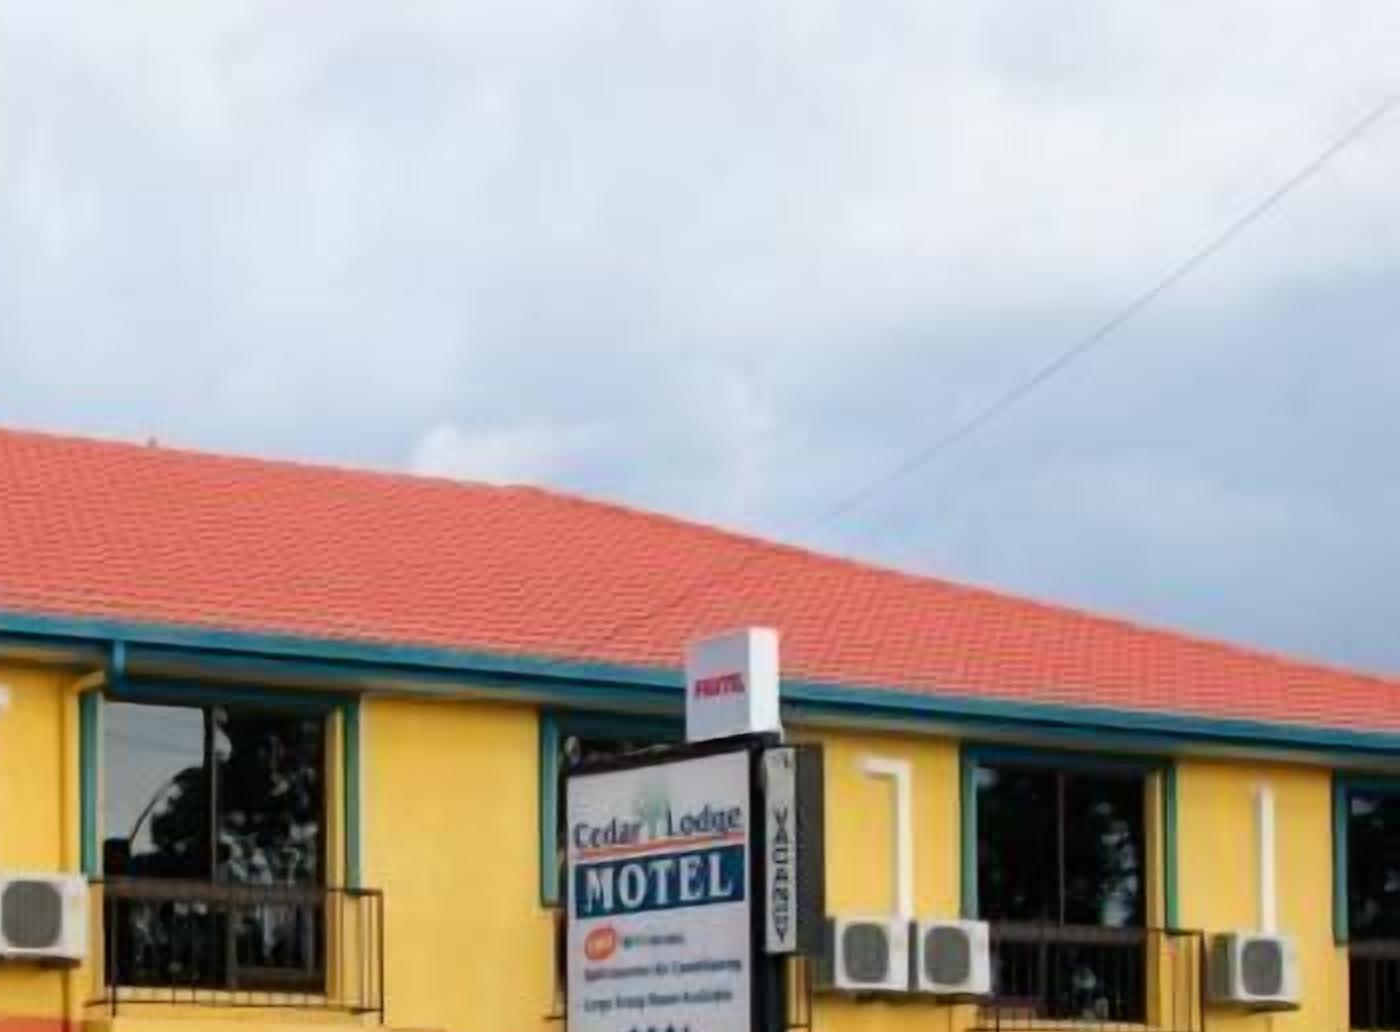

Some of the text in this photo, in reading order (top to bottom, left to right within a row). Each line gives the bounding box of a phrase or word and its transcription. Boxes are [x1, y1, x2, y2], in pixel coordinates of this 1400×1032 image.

[574, 804, 742, 849] Cedar Lodge
[585, 853, 733, 913] MOTEL
[773, 805, 789, 944] VACANCY
